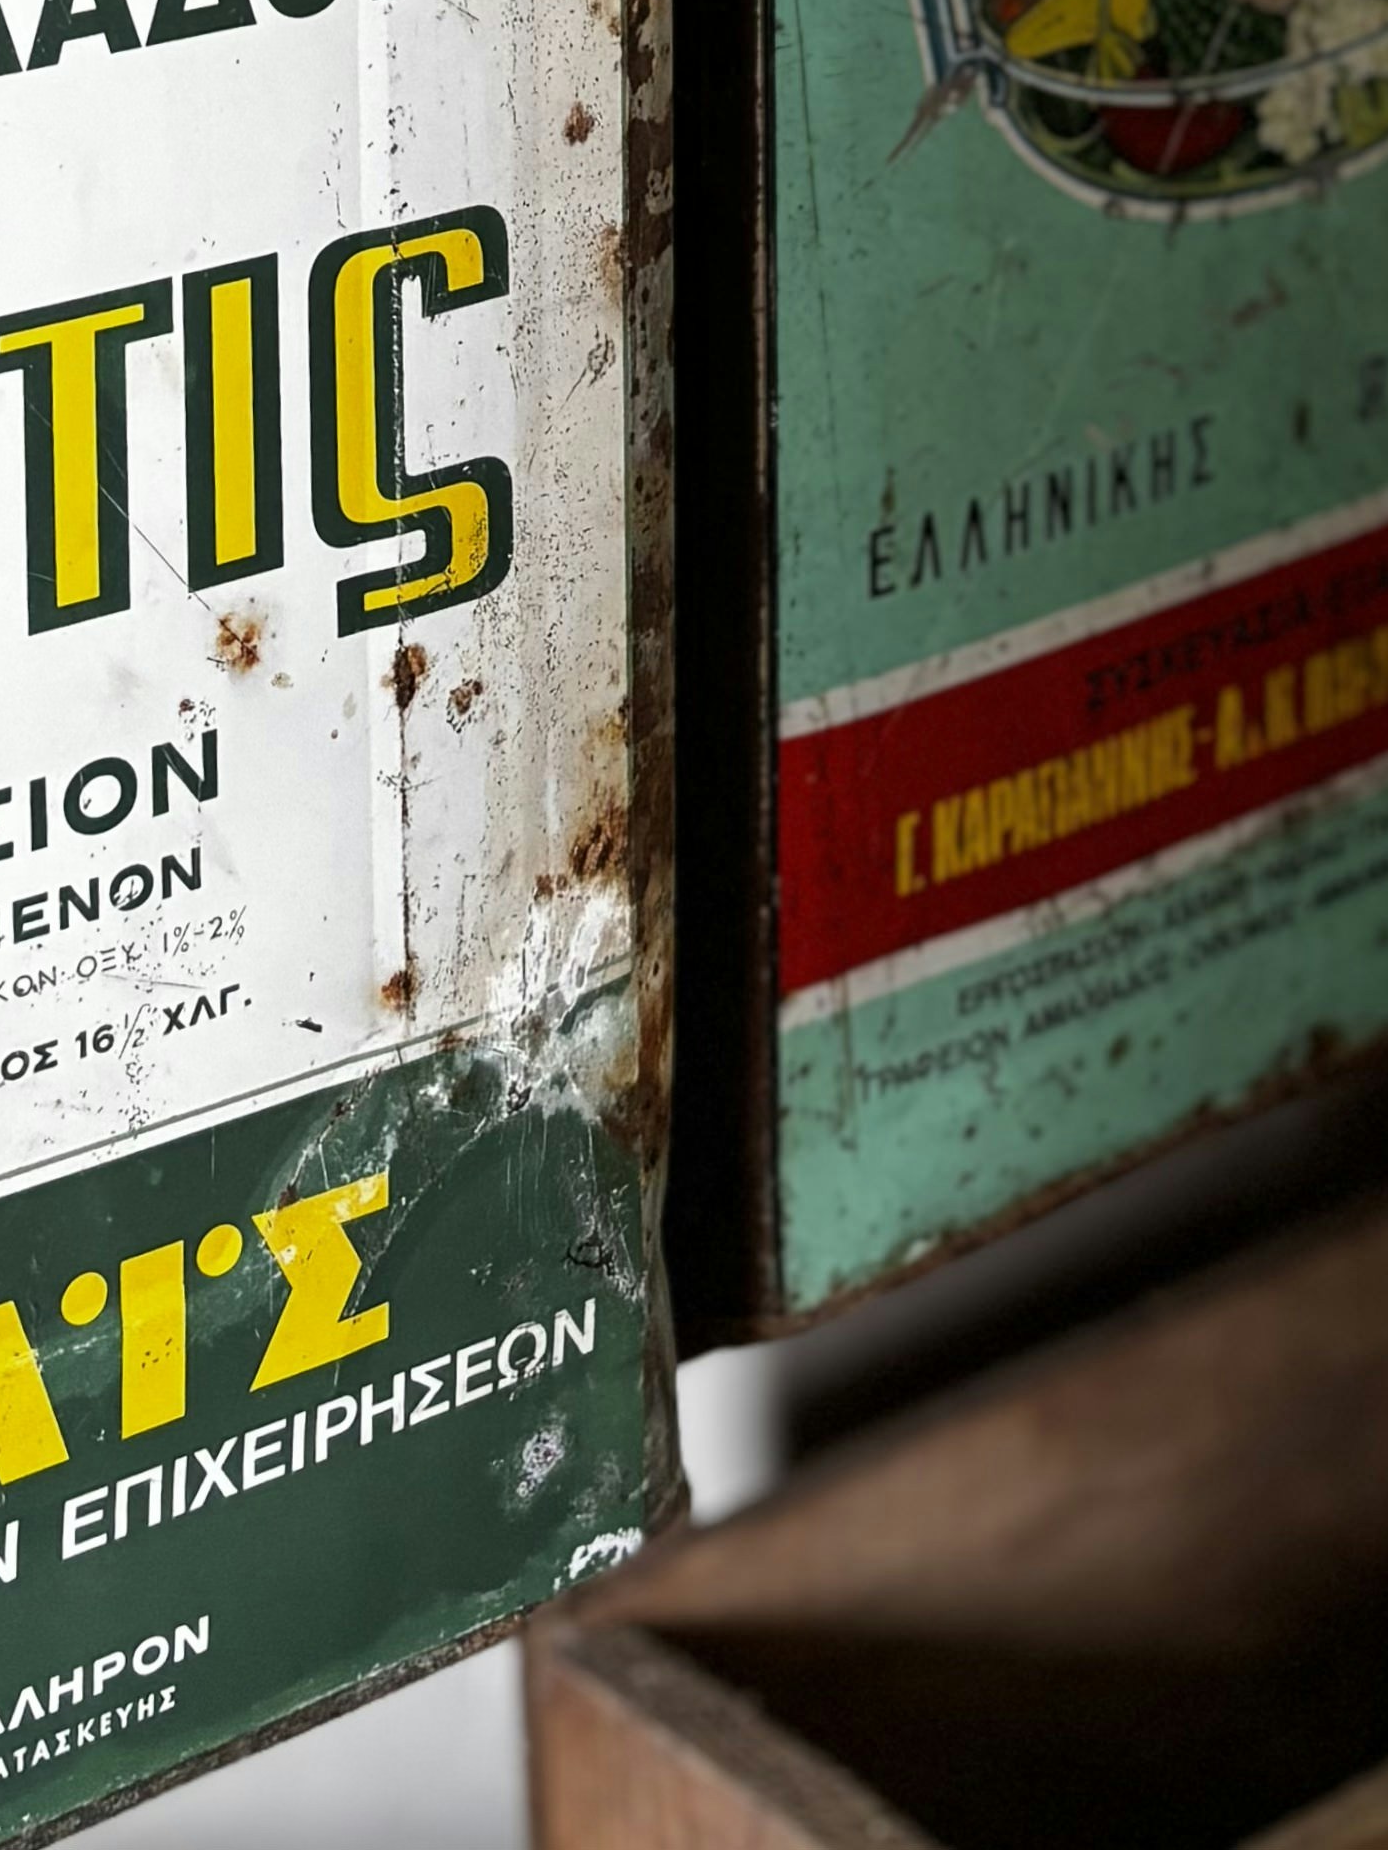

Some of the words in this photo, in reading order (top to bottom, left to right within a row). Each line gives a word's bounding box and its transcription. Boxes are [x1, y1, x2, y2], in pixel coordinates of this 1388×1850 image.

[869, 413, 1213, 599] ΕΛΛΗΝΙΚΗΣ
[163, 983, 252, 1035] ΧΛΓ.
[62, 1299, 599, 1561] ΕΠΙΧΕΙΡΗΣΕΩΝ
